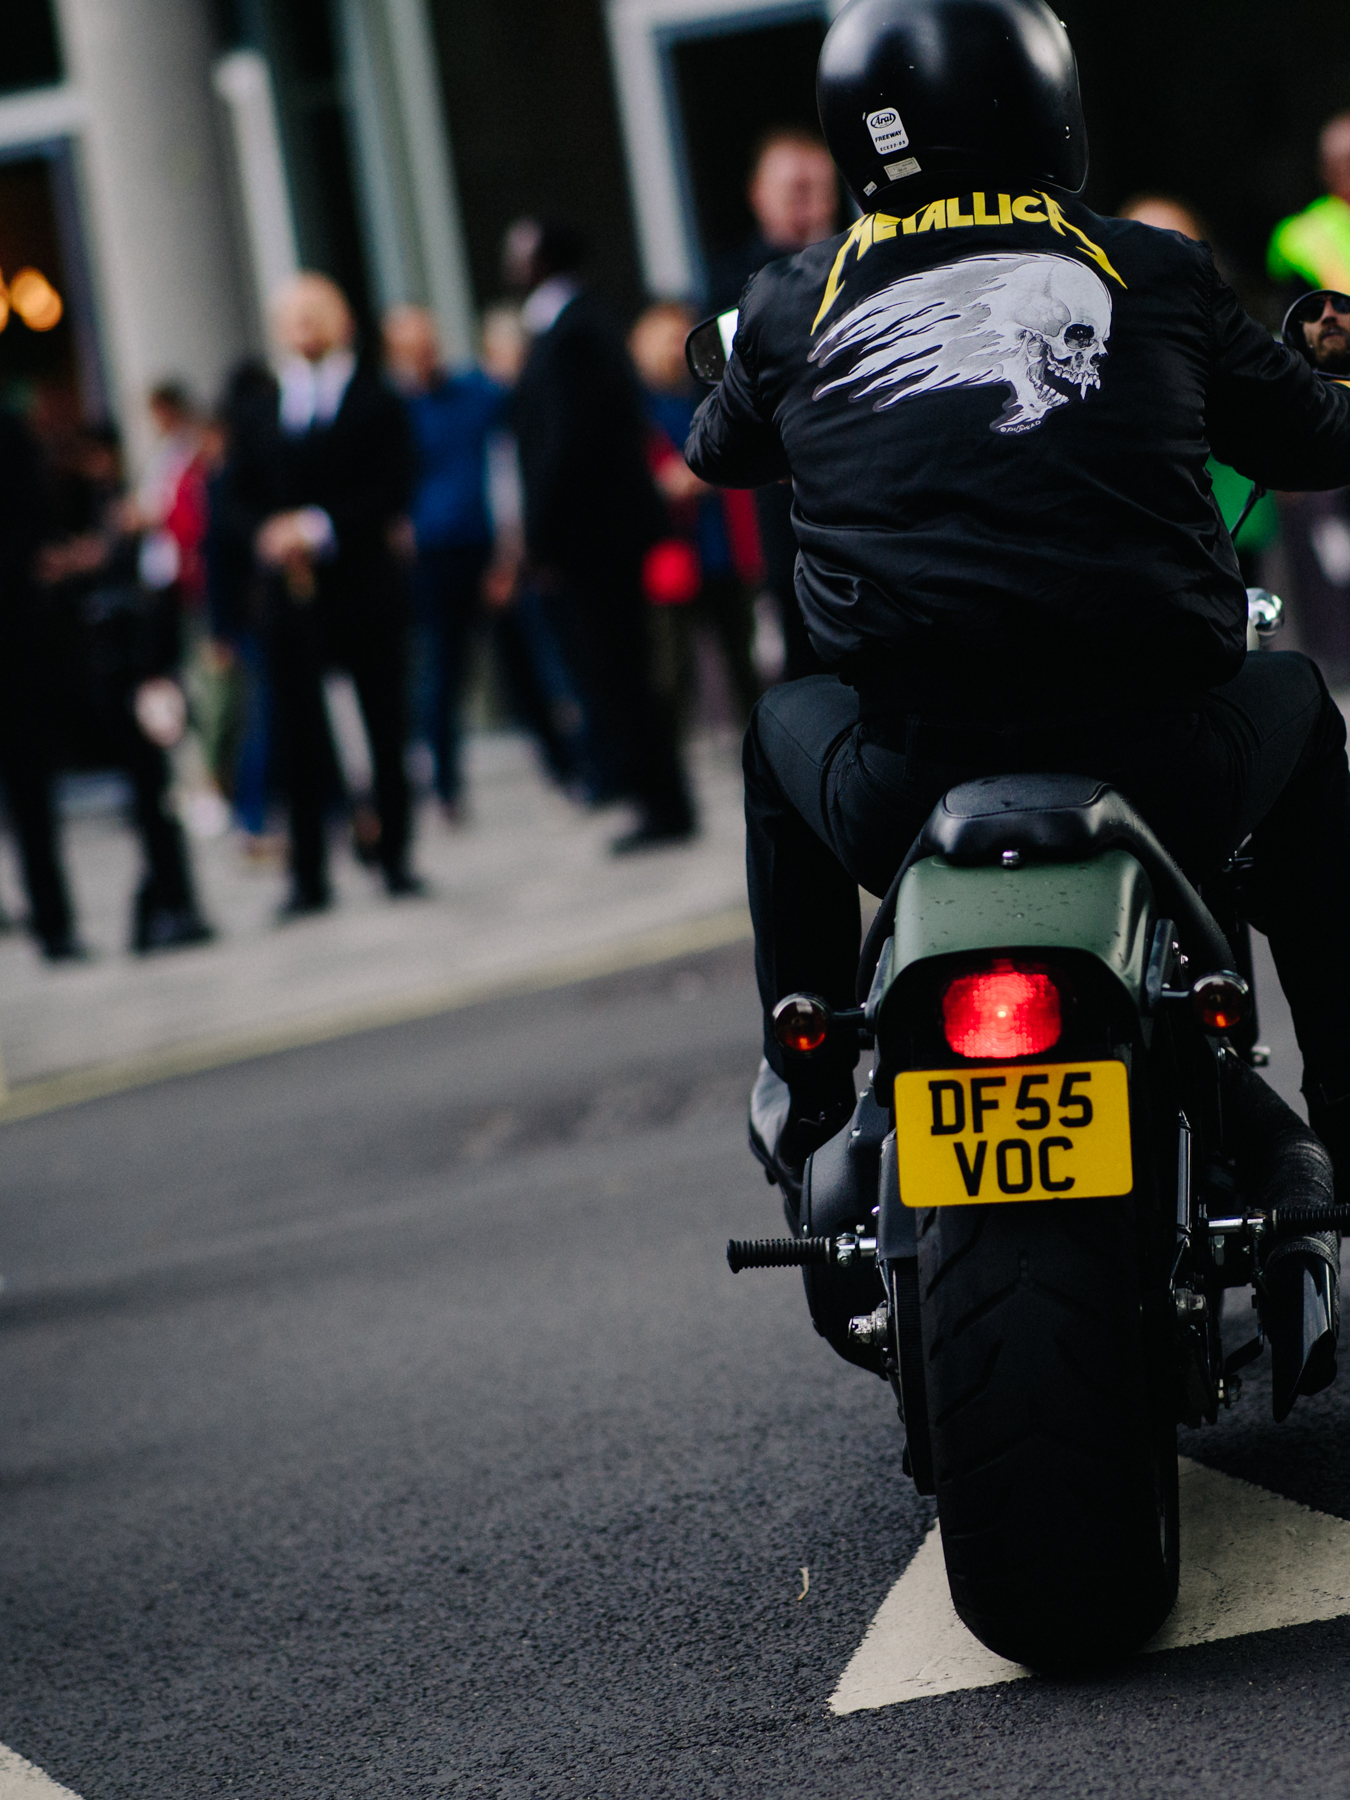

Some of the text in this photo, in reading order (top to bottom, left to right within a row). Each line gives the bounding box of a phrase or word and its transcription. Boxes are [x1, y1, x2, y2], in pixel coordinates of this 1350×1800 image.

[875, 130, 902, 142] FREEWAY
[810, 189, 1128, 336] METALLICA
[928, 1072, 1093, 1135] DF55
[953, 1136, 1075, 1197] VOC
